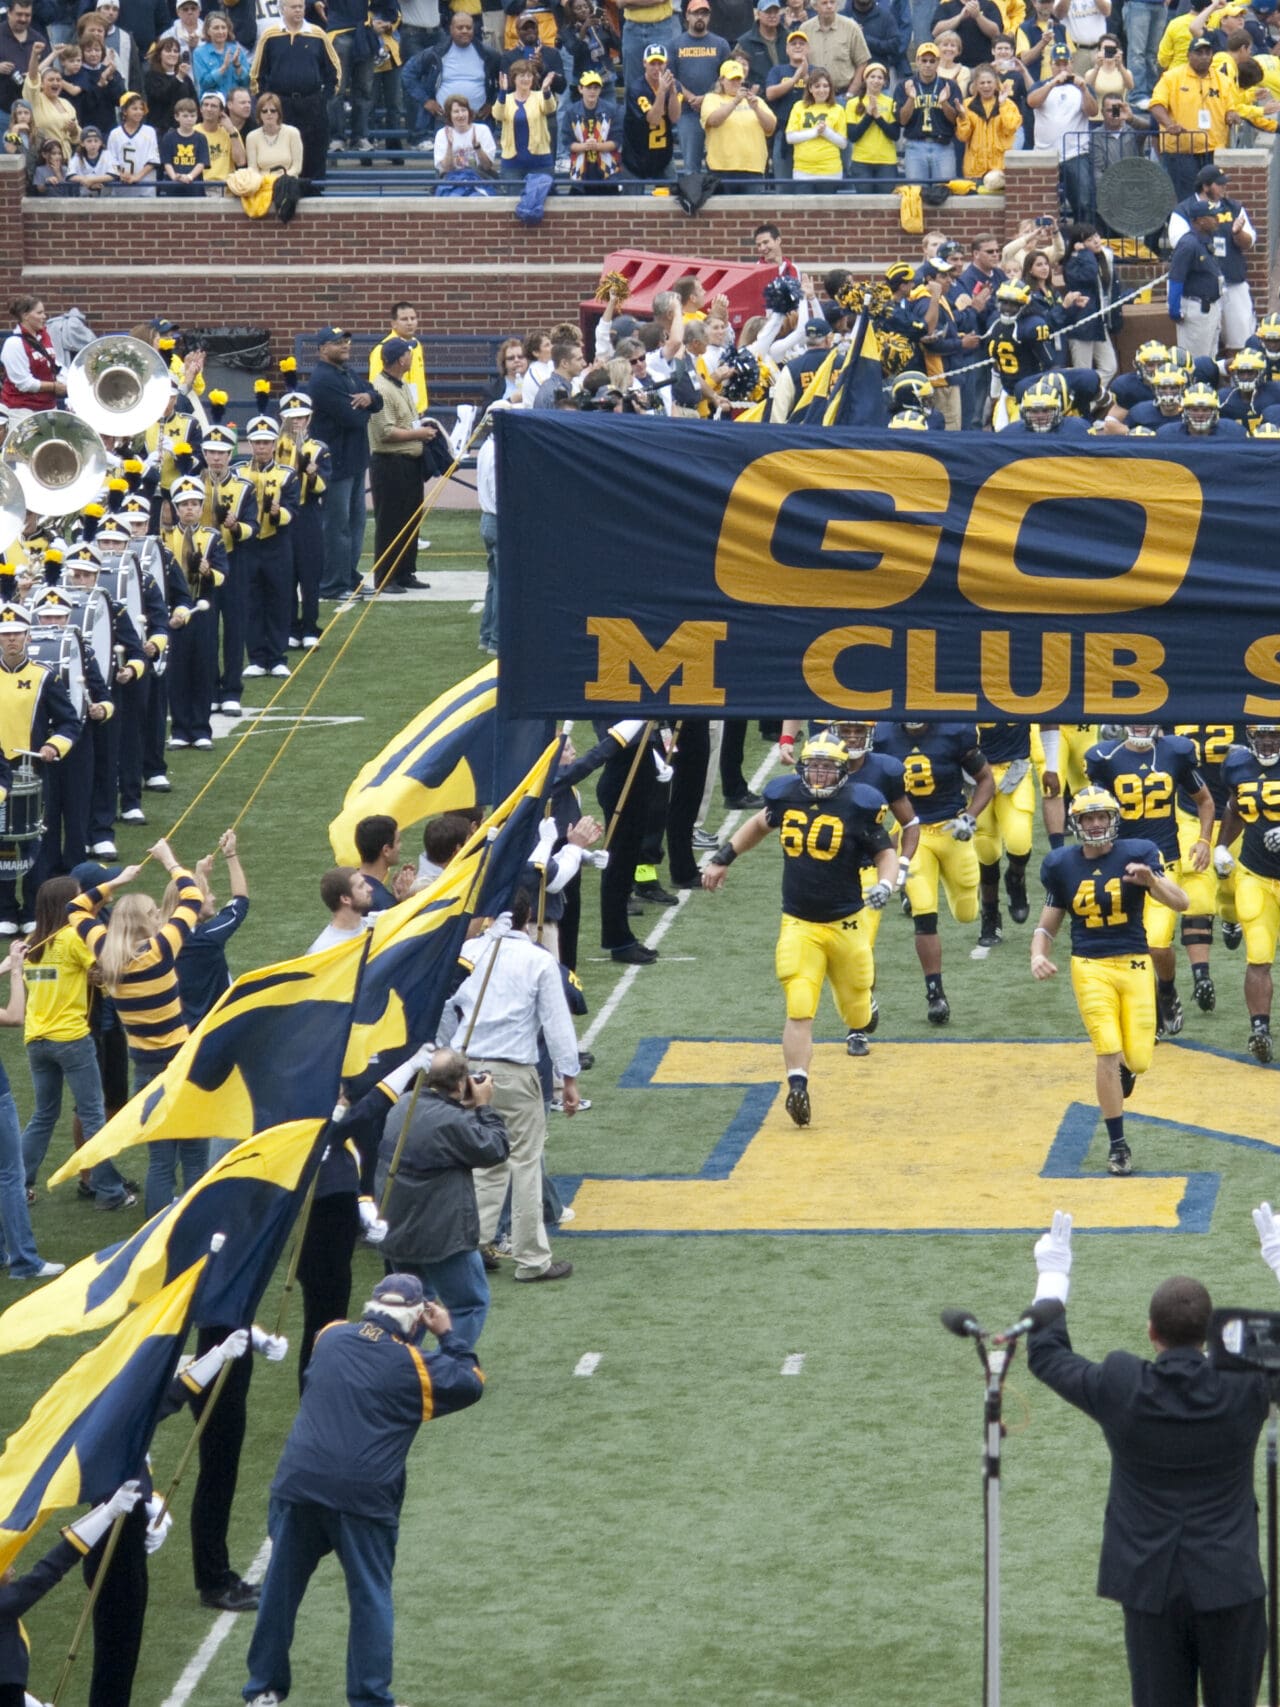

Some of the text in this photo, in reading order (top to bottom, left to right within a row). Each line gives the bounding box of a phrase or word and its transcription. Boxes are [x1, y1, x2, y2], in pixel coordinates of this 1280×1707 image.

[678, 47, 717, 58] MICHIGAN
[1209, 88, 1220, 98] M
[802, 112, 827, 128] M
[177, 144, 194, 158] M
[1217, 212, 1233, 223] M
[714, 448, 1203, 614] GO
[584, 616, 728, 706] M
[802, 625, 1170, 715] CLUB
[17, 680, 31, 689] M
[1113, 771, 1174, 820] 92
[780, 809, 844, 861] 60
[1072, 878, 1128, 928] 41
[842, 921, 858, 930] M
[1130, 960, 1146, 970] M
[359, 1321, 384, 1342] M
